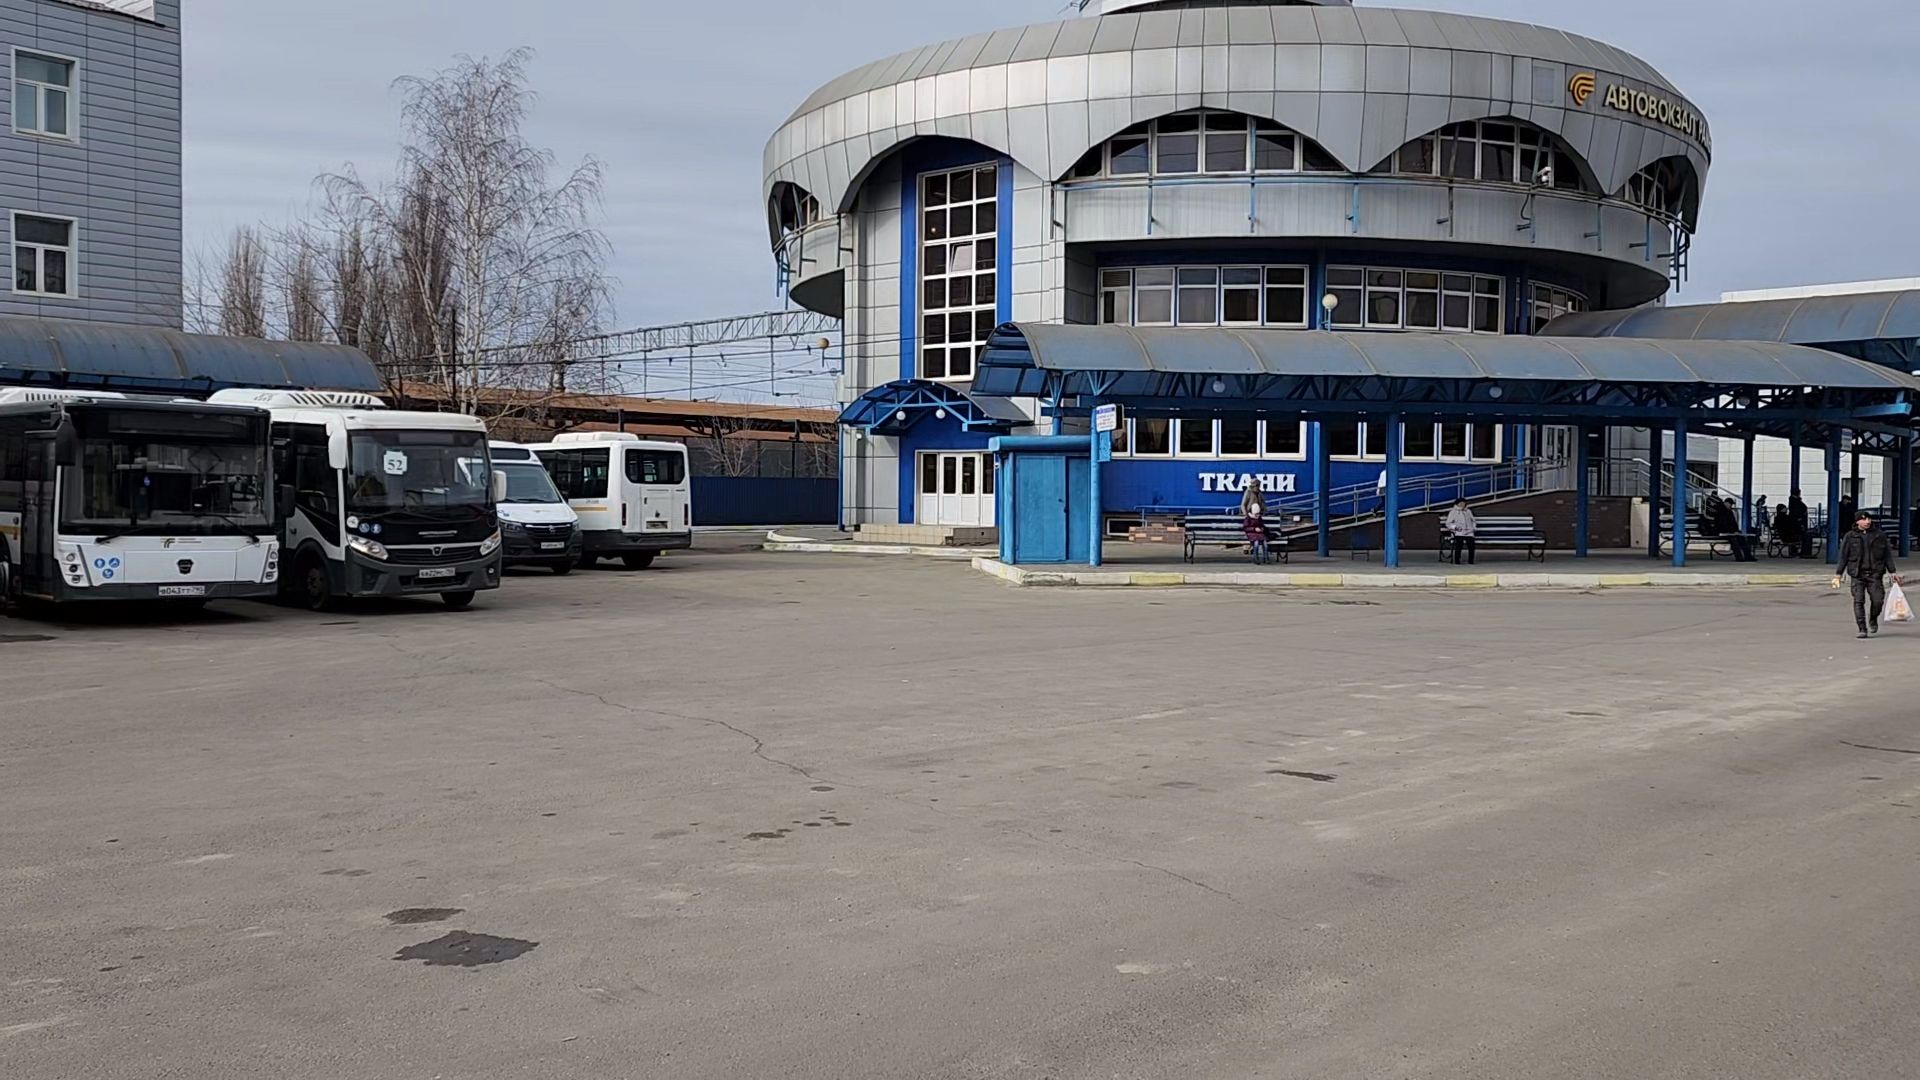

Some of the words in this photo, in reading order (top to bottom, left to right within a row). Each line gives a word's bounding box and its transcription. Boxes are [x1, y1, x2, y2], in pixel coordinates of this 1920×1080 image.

[1603, 83, 1696, 136] АВТОВОКЗАЛ
[387, 459, 403, 471] 52
[1198, 472, 1296, 492] ТКАНИ
